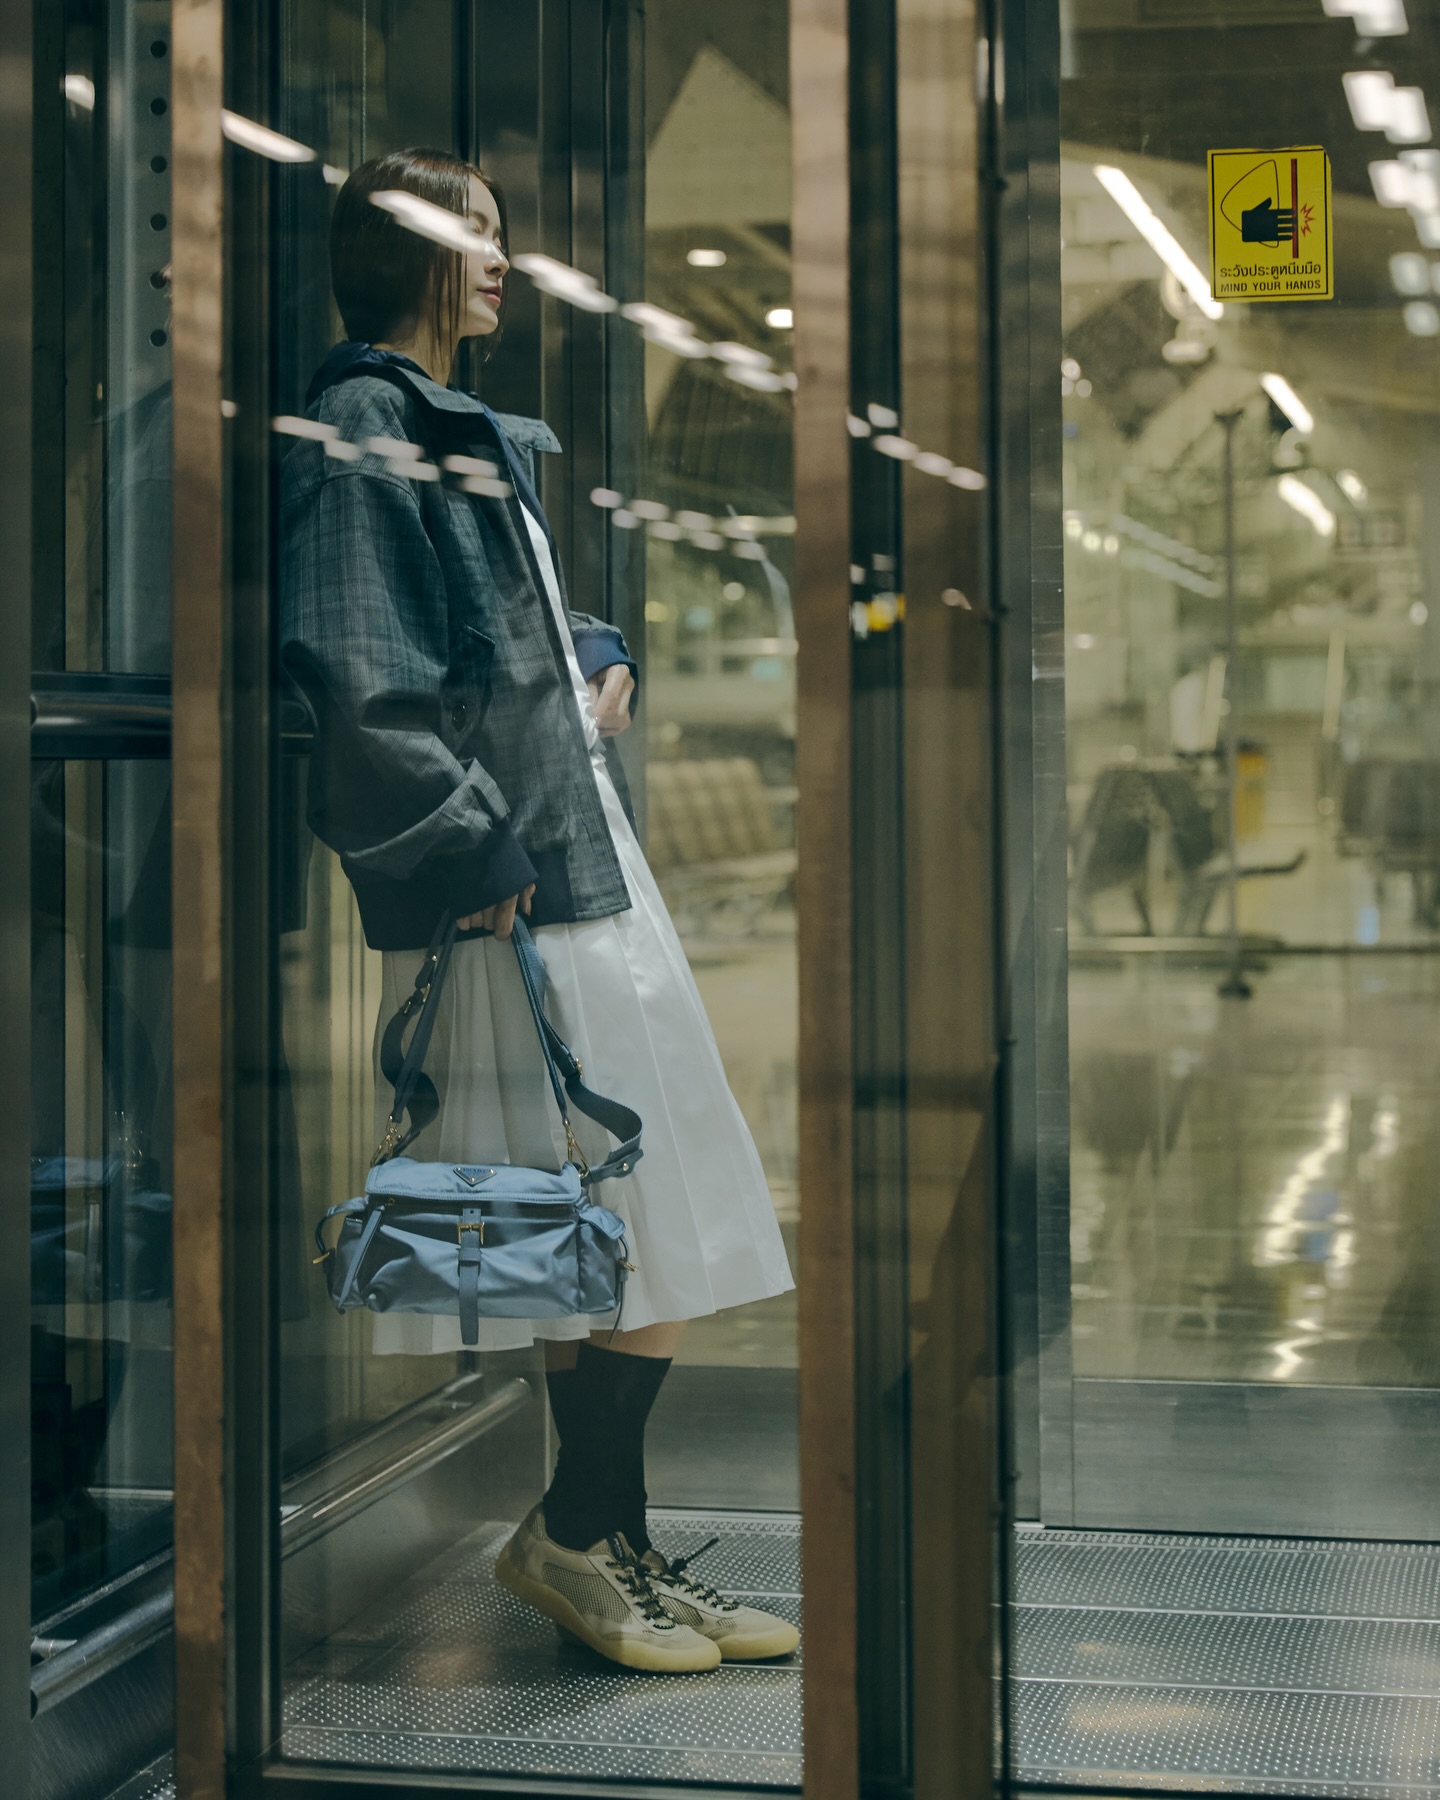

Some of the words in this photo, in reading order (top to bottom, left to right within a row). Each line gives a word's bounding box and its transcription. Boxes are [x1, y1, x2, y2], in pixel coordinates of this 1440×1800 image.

[1220, 262, 1322, 280] ระวังประตูหนีบมือ
[1220, 282, 1248, 293] MIND
[1252, 281, 1281, 291] YOUR
[1286, 280, 1321, 290] HANDS
